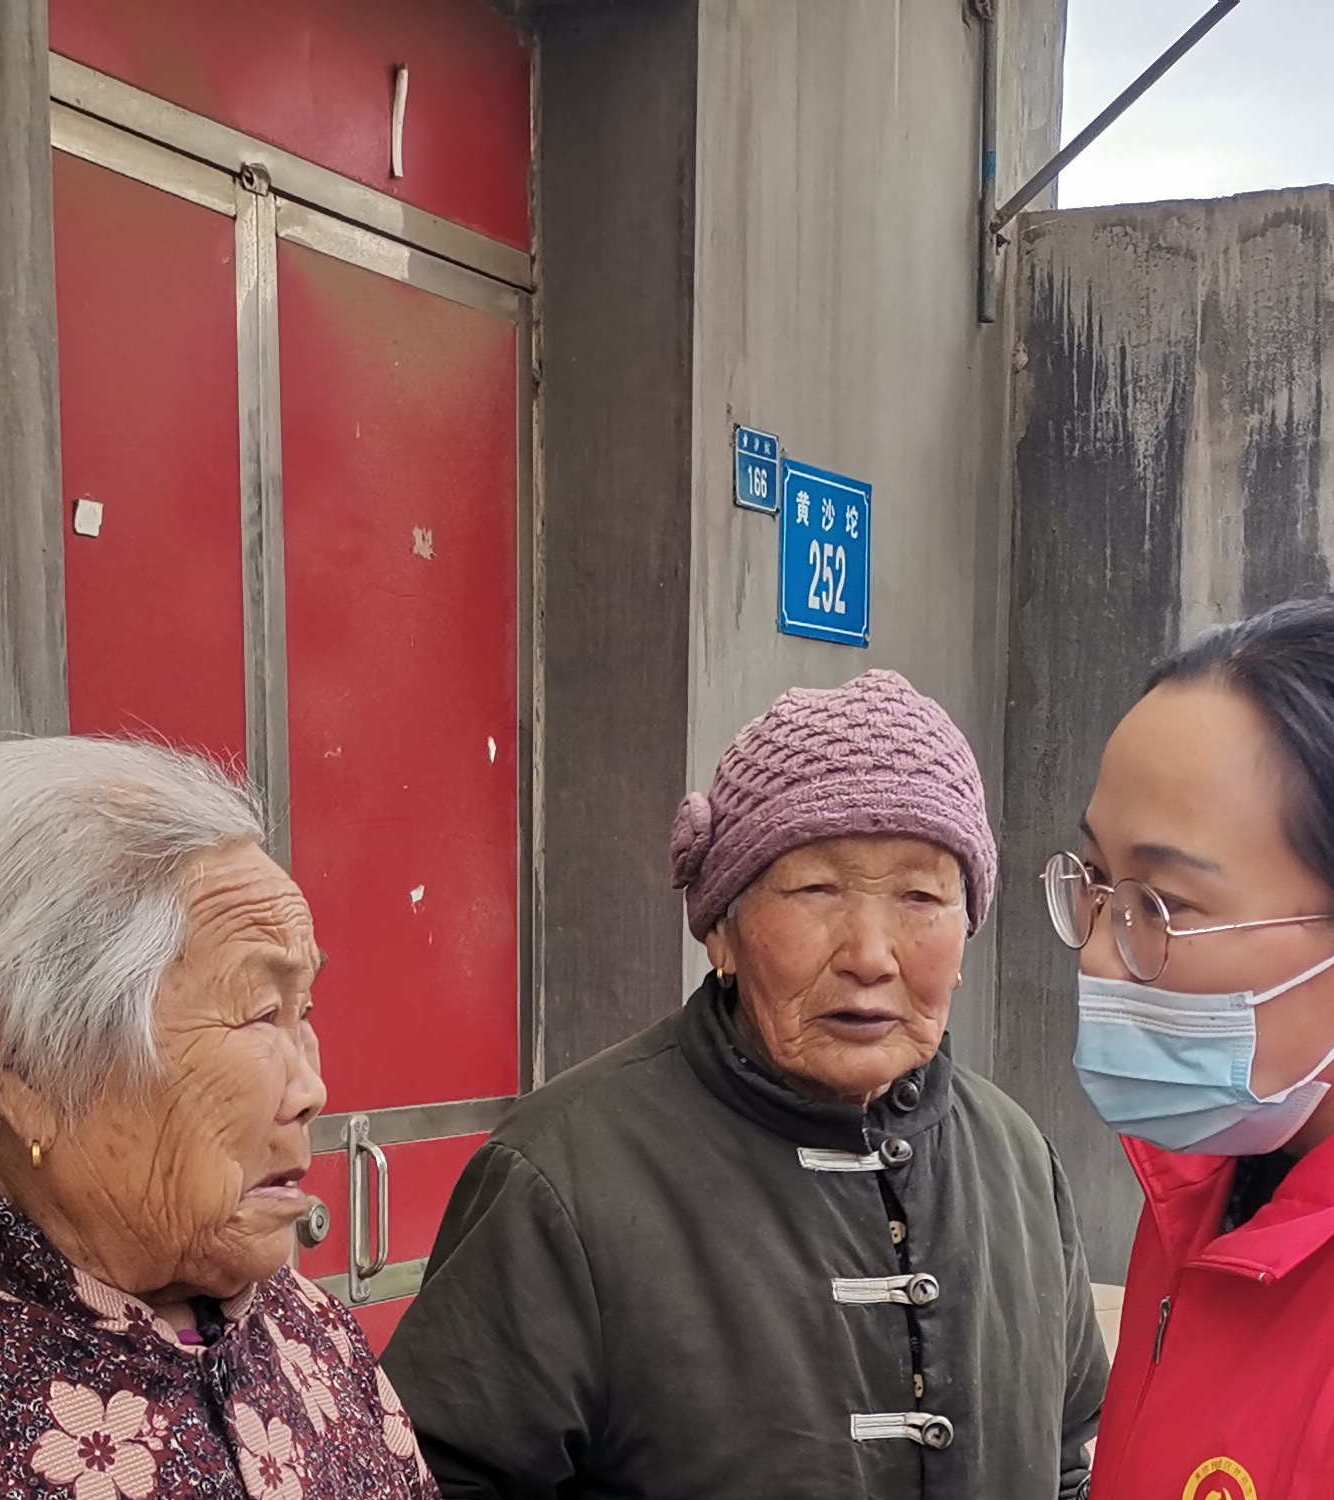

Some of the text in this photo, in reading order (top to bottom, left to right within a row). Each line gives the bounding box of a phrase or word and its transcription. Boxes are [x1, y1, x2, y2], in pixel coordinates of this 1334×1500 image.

[747, 464, 767, 498] 166
[795, 489, 859, 539] 黄沙坨
[807, 538, 847, 615] 252
